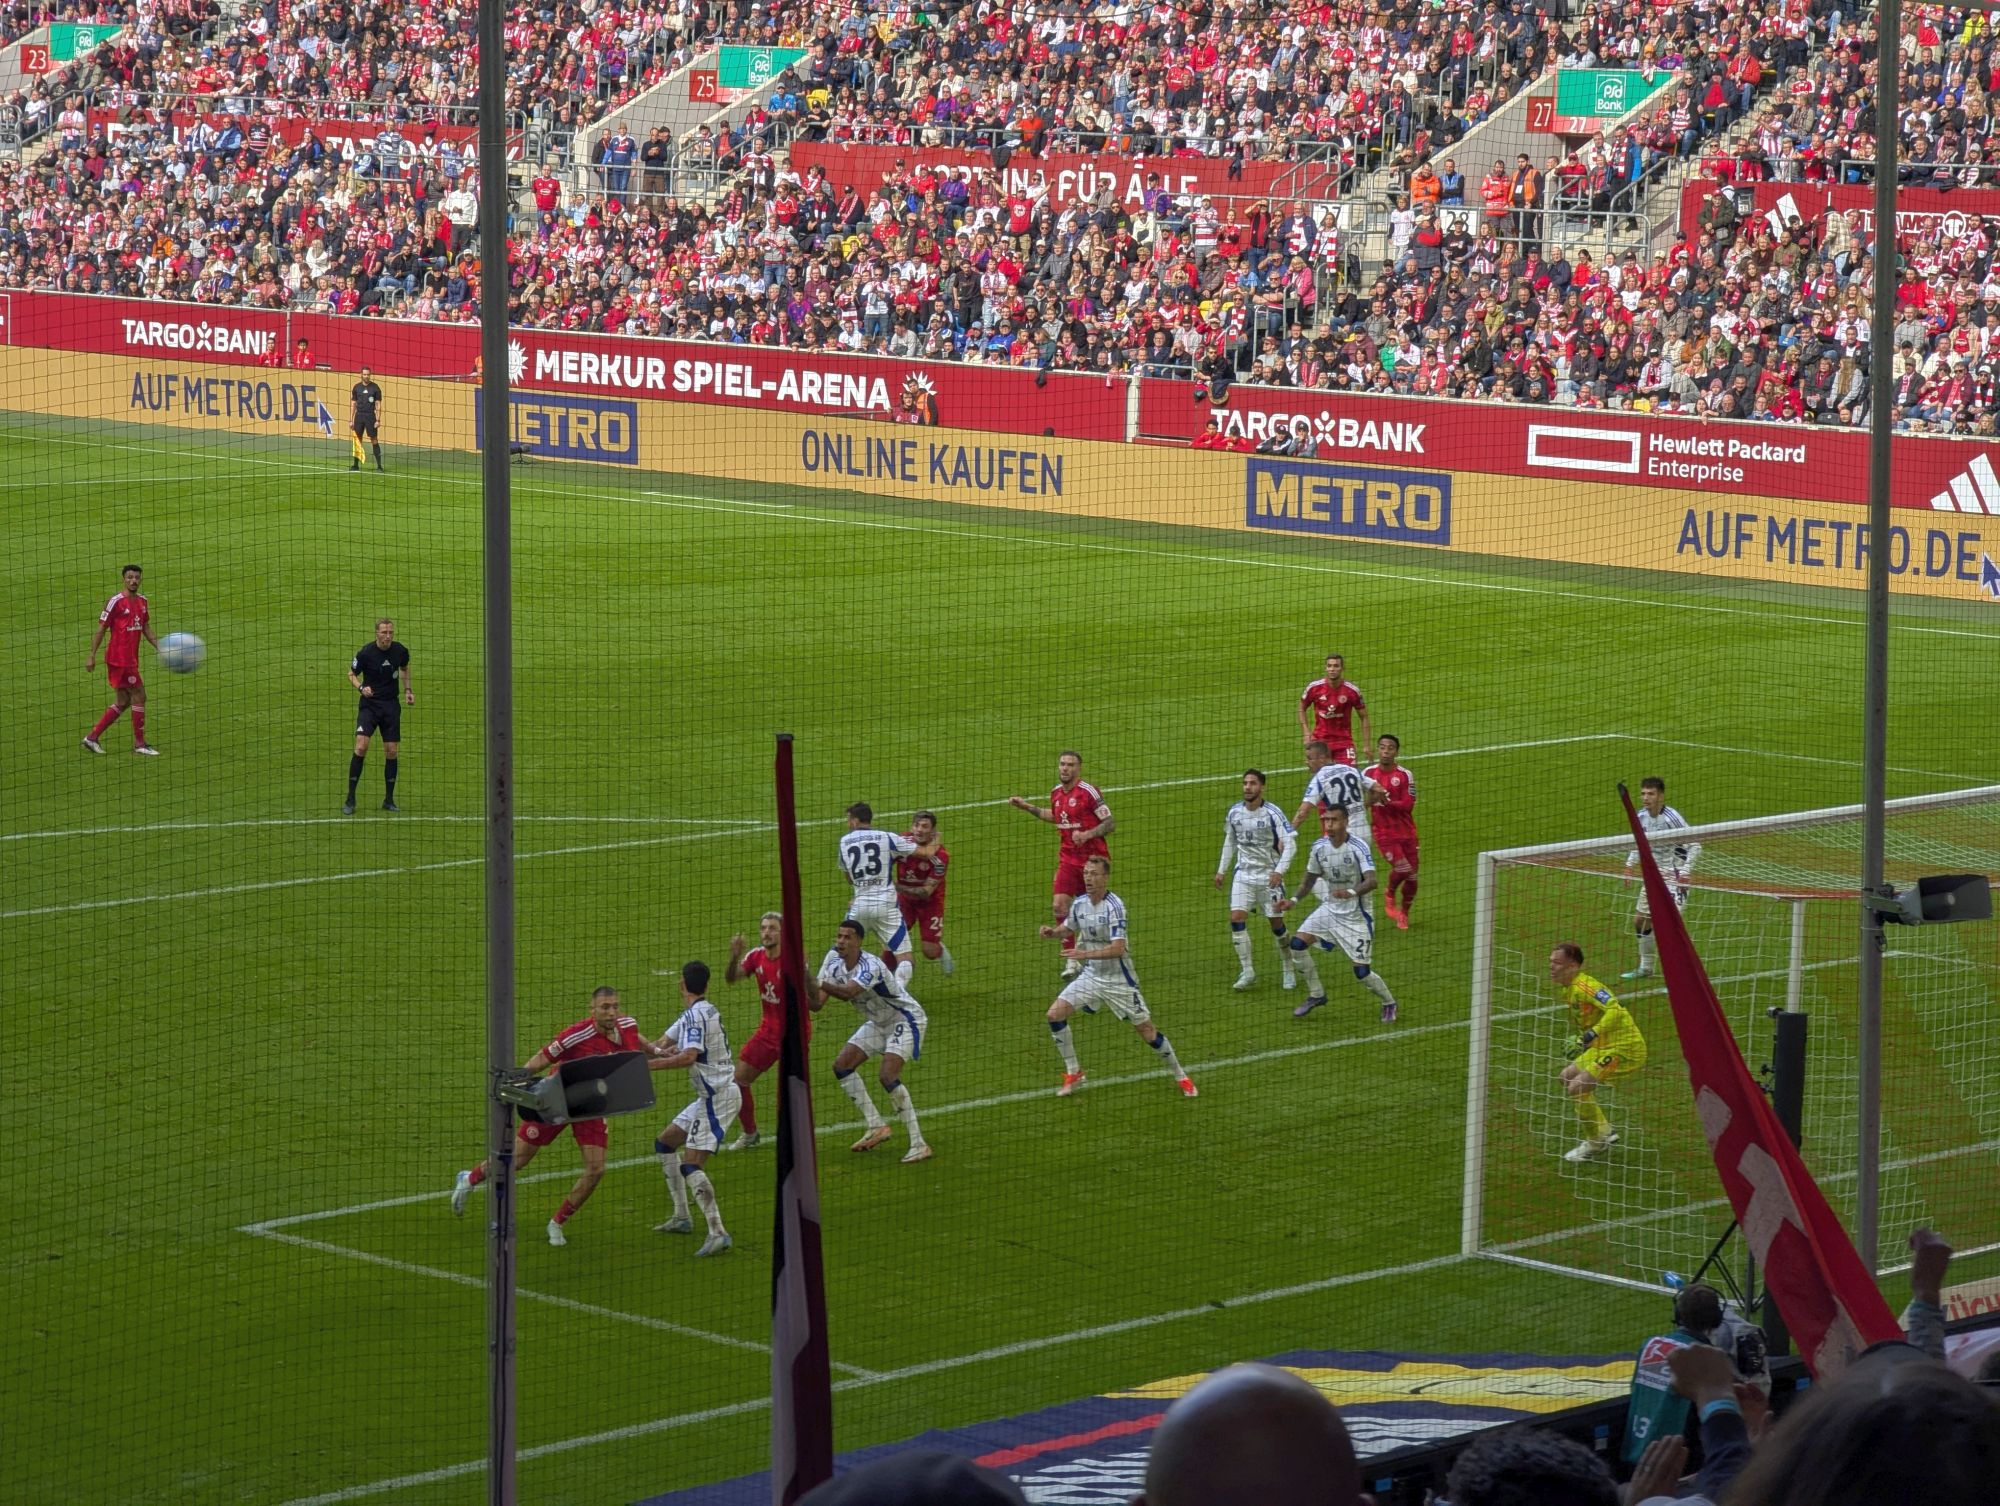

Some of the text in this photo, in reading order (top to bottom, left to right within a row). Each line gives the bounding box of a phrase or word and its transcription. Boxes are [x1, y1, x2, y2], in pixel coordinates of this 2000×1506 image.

[28, 50, 46, 70] 23
[697, 76, 715, 97] 25
[1533, 103, 1552, 127] 27
[1597, 101, 1622, 111] Bank
[1570, 117, 1587, 133] 27
[535, 349, 892, 411] MERKUR SPIEL-ARENA
[131, 371, 319, 424] AUF METRO.DE
[1649, 433, 1806, 464] Hewlett Packard
[801, 429, 1063, 498] ONLINE KAUFEN
[1648, 457, 1744, 483] Enterprise
[1256, 470, 1442, 532] METRO
[1676, 508, 1758, 559] AUF
[1330, 772, 1362, 806] 28
[848, 842, 883, 880] 23
[894, 1023, 904, 1038] 9
[691, 1119, 700, 1135] 8
